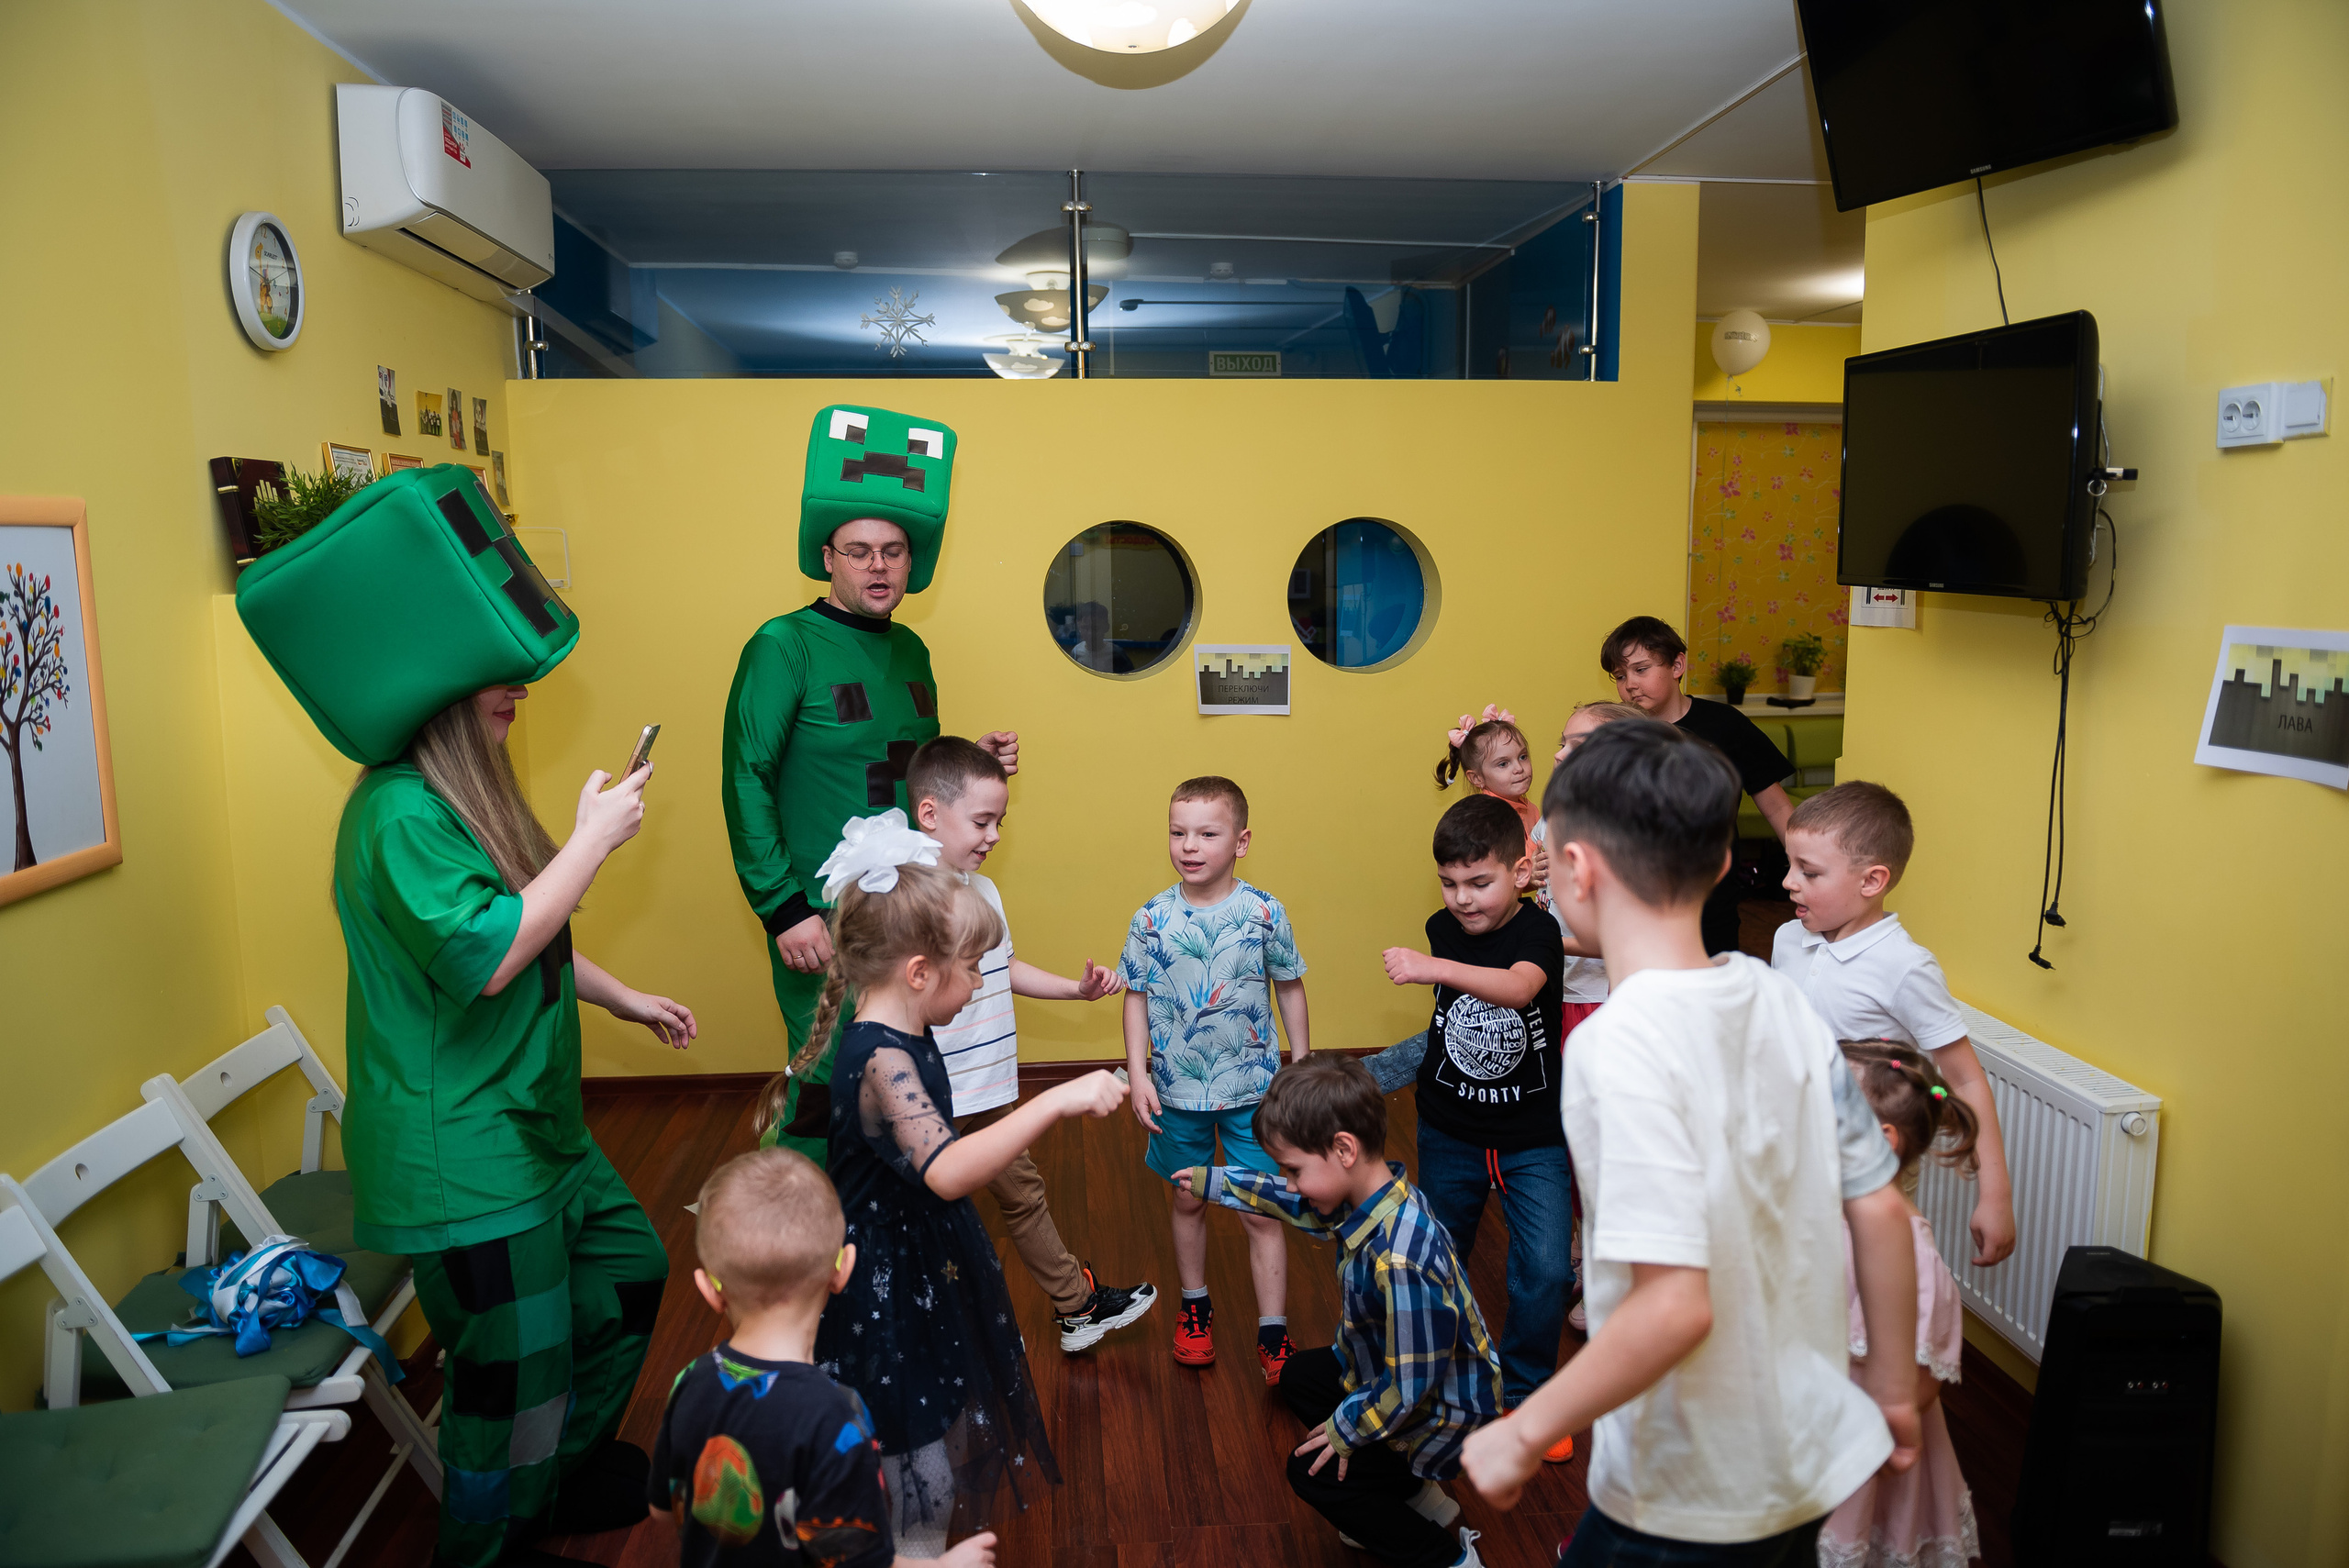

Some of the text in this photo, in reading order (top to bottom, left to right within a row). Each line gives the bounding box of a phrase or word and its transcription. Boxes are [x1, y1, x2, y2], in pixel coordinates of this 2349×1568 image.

[1216, 356, 1274, 372] ВЫХОД
[1218, 684, 1270, 693] ПЕРЕКЛЮЧИ
[2277, 714, 2313, 733] ЛАВА
[1482, 1018, 1523, 1033] POWERFUL
[1527, 1006, 1547, 1051] TEAM
[1503, 1028, 1523, 1040] PLAY
[1503, 1038, 1525, 1051] HOOP
[1483, 1059, 1506, 1075] LUCK
[1491, 1051, 1520, 1068] HIGH
[1458, 1082, 1520, 1104] SPORTY
